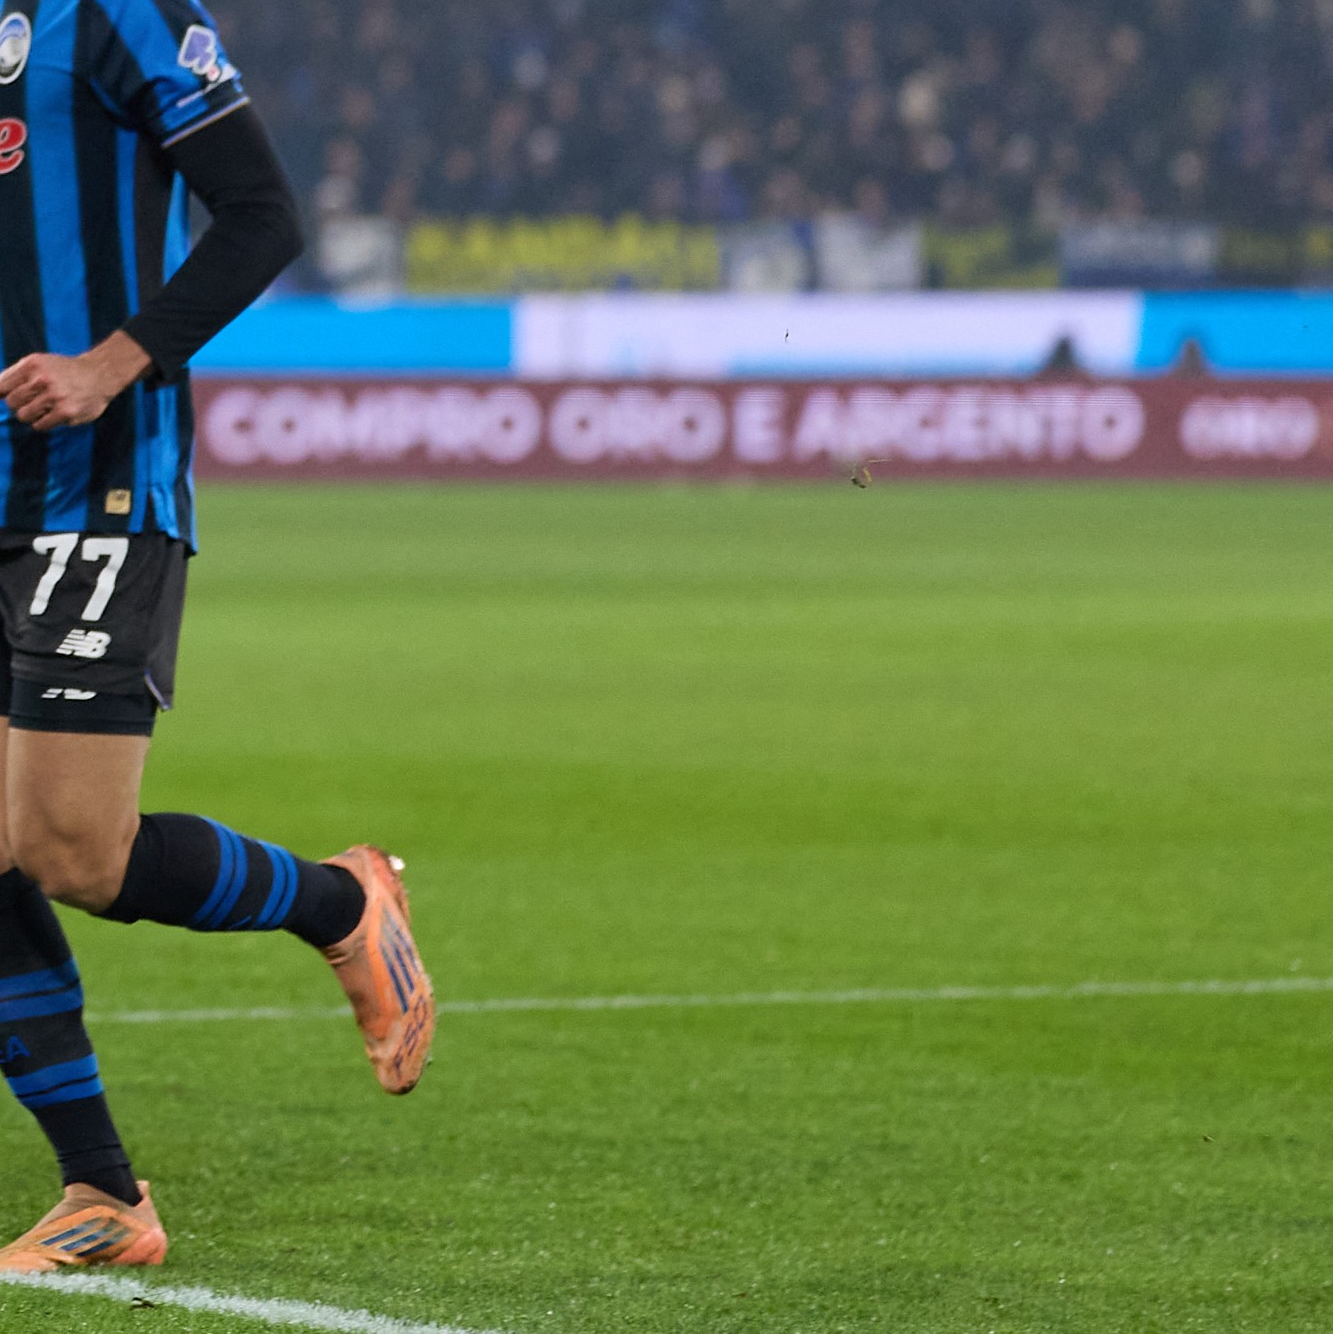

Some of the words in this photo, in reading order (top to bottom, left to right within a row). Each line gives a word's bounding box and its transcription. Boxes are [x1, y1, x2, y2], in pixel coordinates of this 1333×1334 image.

[204, 387, 542, 465] COMPRO
[549, 387, 727, 464] ORO
[737, 387, 785, 463] E
[792, 385, 1146, 463] ARGENTO
[29, 532, 129, 622] 77
